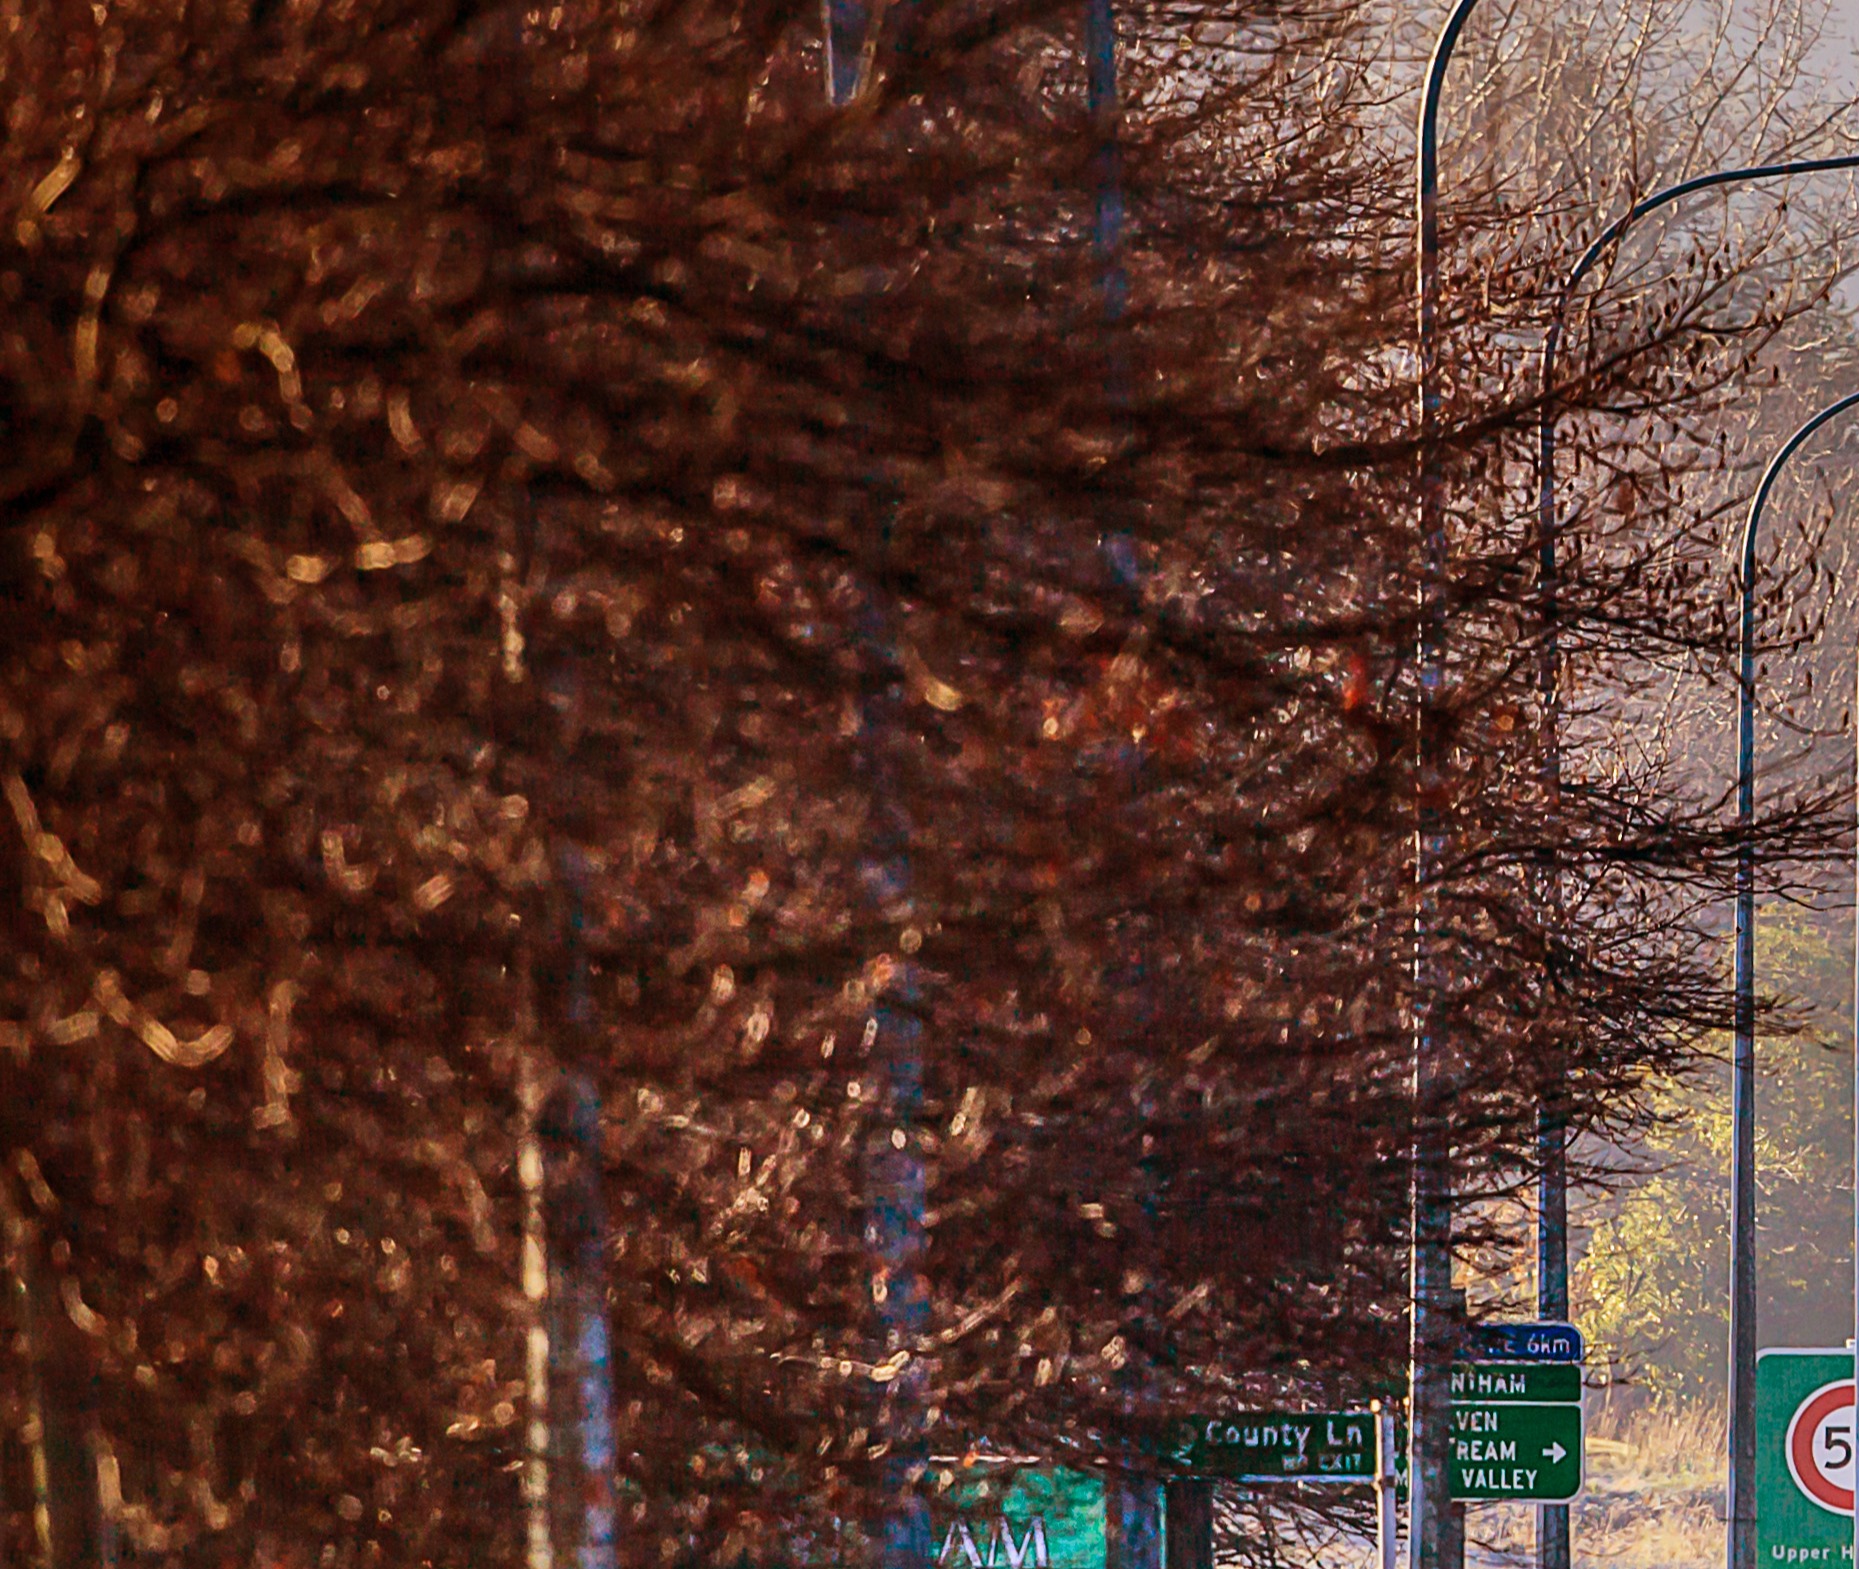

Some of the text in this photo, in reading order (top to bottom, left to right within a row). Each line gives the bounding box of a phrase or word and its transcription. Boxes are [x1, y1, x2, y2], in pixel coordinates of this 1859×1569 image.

[1205, 1419, 1363, 1455] County Ln
[1461, 1468, 1538, 1491] VALLEY
[1772, 1545, 1830, 1563] Upper
